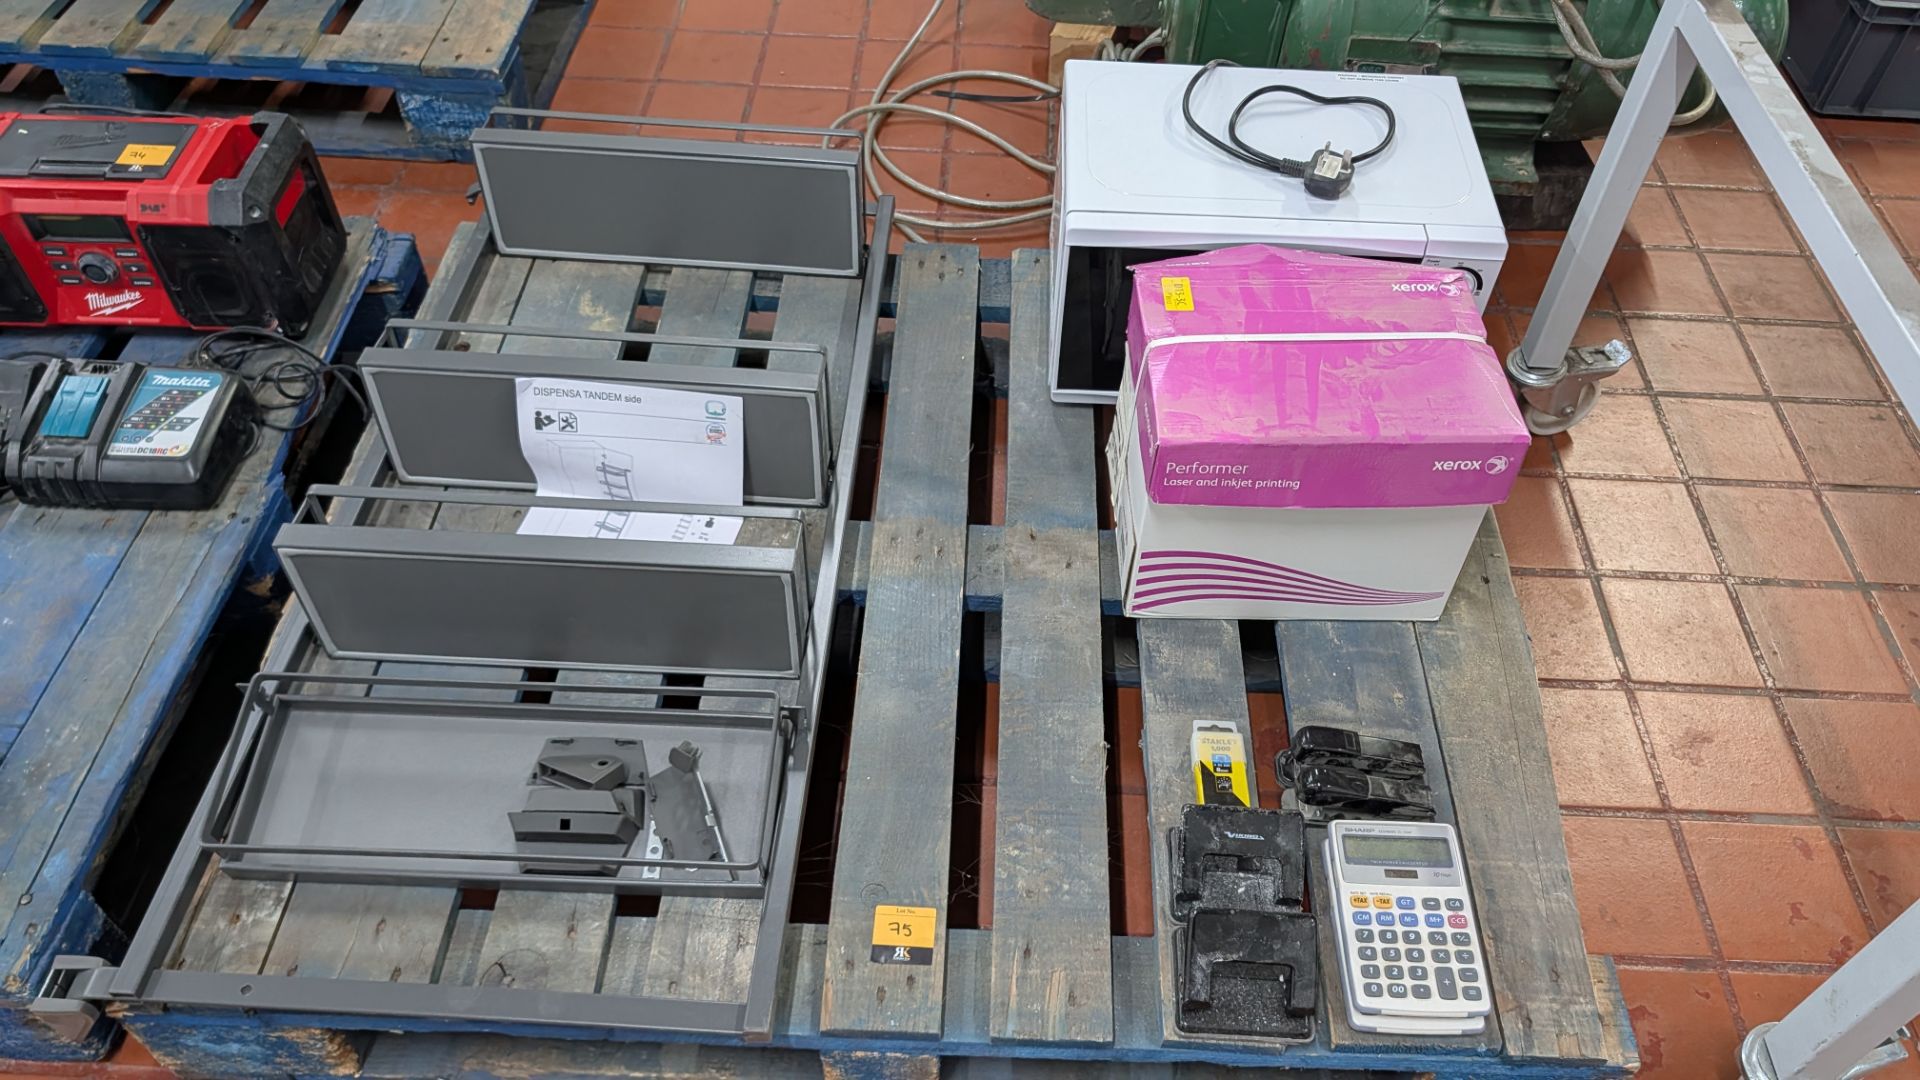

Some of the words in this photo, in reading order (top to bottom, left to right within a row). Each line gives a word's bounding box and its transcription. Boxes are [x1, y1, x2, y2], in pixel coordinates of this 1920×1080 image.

[1391, 283, 1437, 292] xerox
[84, 289, 143, 312] Milwaukee
[151, 374, 211, 387] makita
[533, 387, 582, 398] DISPENSA
[583, 390, 622, 402] TANDEM
[624, 395, 642, 404] side
[1165, 461, 1249, 475] Performer
[1432, 459, 1482, 471] xerox
[1163, 478, 1194, 487] Laser
[1195, 478, 1218, 487] and
[1220, 478, 1253, 489] inkjet
[1255, 479, 1300, 490] printing
[888, 921, 912, 937] 75
[1362, 930, 1369, 938] 7
[1412, 950, 1419, 958] 6
[1416, 968, 1422, 976] 3
[1391, 985, 1405, 993] 00
